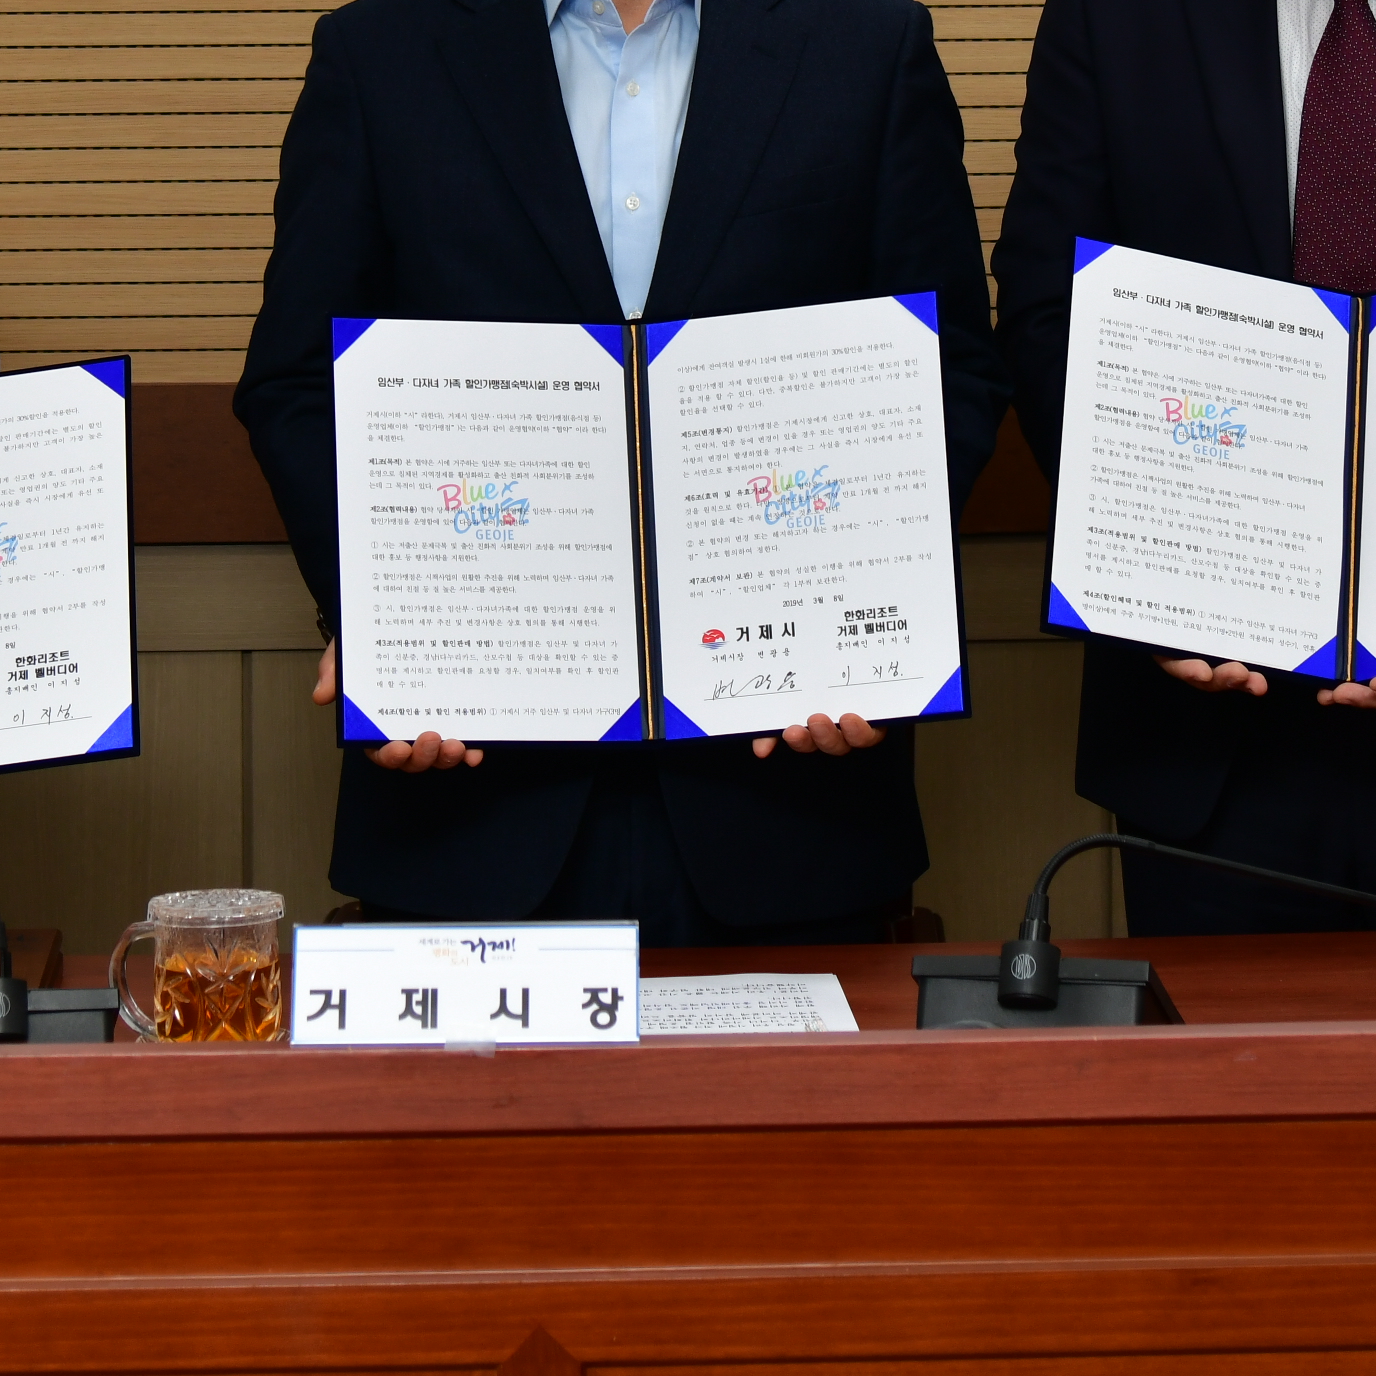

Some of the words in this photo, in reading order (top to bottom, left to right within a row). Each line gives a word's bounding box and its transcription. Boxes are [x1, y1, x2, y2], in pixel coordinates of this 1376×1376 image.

[1112, 287, 1137, 300] 임산부
[1145, 294, 1170, 308] 다자녀
[1174, 300, 1191, 312] 가족
[1278, 322, 1294, 333] 운영
[1298, 326, 1323, 339] 협약서
[377, 376, 403, 387] 임산부
[412, 377, 439, 388] 다자녀
[443, 378, 460, 388] 가족
[552, 380, 569, 391] 운영
[573, 380, 600, 391] 협약서
[1160, 395, 1218, 422] Blue
[1193, 443, 1230, 460] GEOJE
[747, 468, 809, 503] Blue
[437, 478, 499, 511] Blue
[786, 514, 826, 529] GEOJE
[475, 529, 515, 542] GEOJE
[782, 598, 803, 607] 2019년
[812, 595, 823, 604] 3월
[833, 593, 843, 602] 8일
[843, 605, 898, 622] 한화리조트
[836, 623, 858, 636] 거제
[863, 618, 907, 634] 벨버디어
[5, 641, 15, 649] 8일
[15, 650, 69, 667] 한화리조트
[7, 669, 28, 681] 거제
[34, 662, 78, 678] 벨버디어
